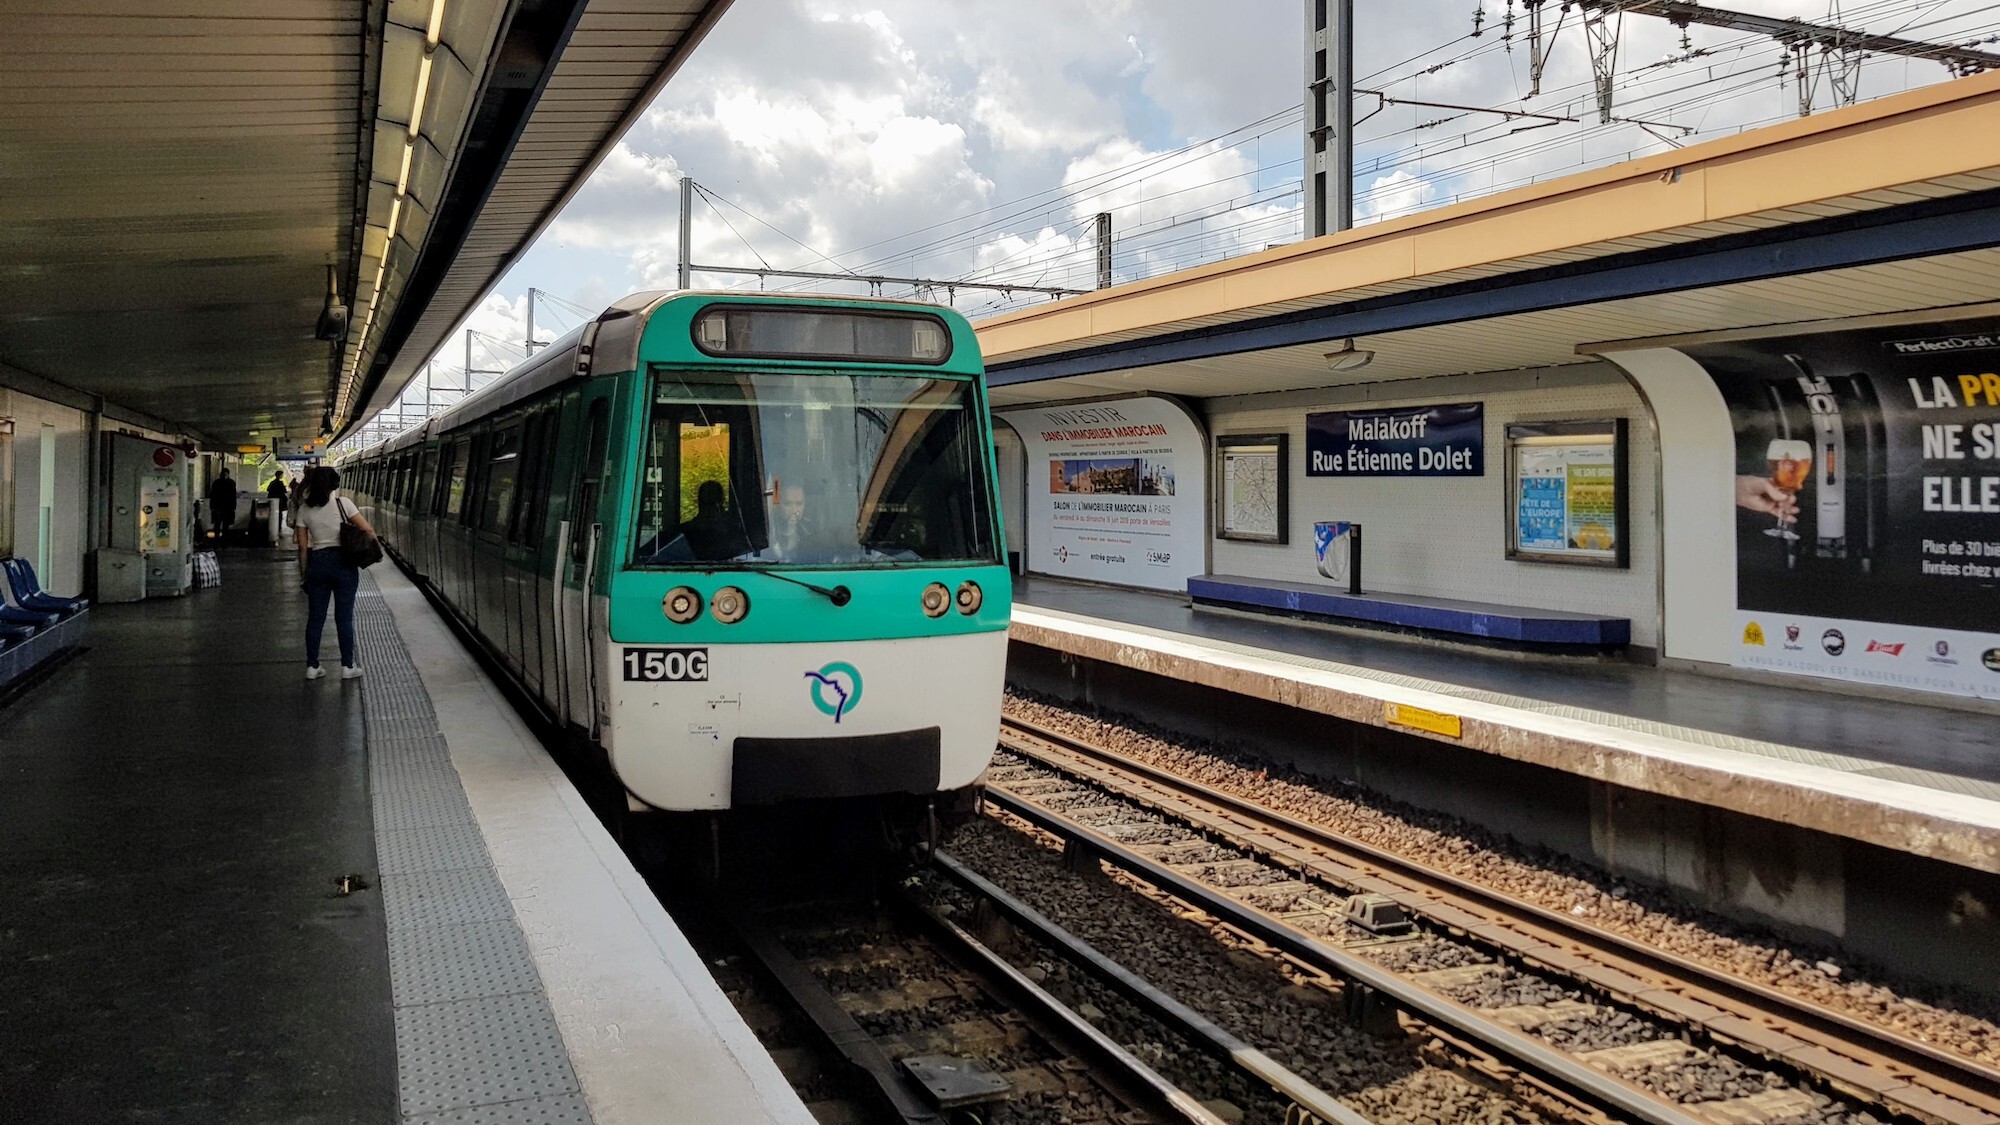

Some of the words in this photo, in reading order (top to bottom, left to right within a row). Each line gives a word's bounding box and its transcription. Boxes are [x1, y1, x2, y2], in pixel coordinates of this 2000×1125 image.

[1894, 336, 1997, 352] PerfectDraft
[1907, 376, 1958, 408] LA
[1043, 407, 1127, 426] INVESTIR
[1348, 414, 1428, 441] Malakoff
[1041, 431, 1064, 442] DANS
[1063, 428, 1113, 441] L'IMMOBILIER
[1112, 424, 1167, 438] MAROCAIN
[1922, 424, 1965, 459] NE
[1312, 450, 1343, 472] Rue
[1347, 444, 1413, 471] Étienne
[1418, 446, 1473, 471] Dolet
[1923, 476, 2000, 513] ELLE
[1053, 501, 1070, 510] SALON
[1078, 501, 1113, 512] L'IMMOBILIER
[1114, 503, 1147, 513] MAROCAIN
[1154, 504, 1171, 514] PARIS
[1922, 539, 1947, 555] Plus
[1948, 541, 1963, 556] de
[1966, 541, 1982, 556] 30
[1922, 560, 1961, 576] livrées
[1961, 562, 1992, 578] chez
[625, 651, 708, 680] 150G
